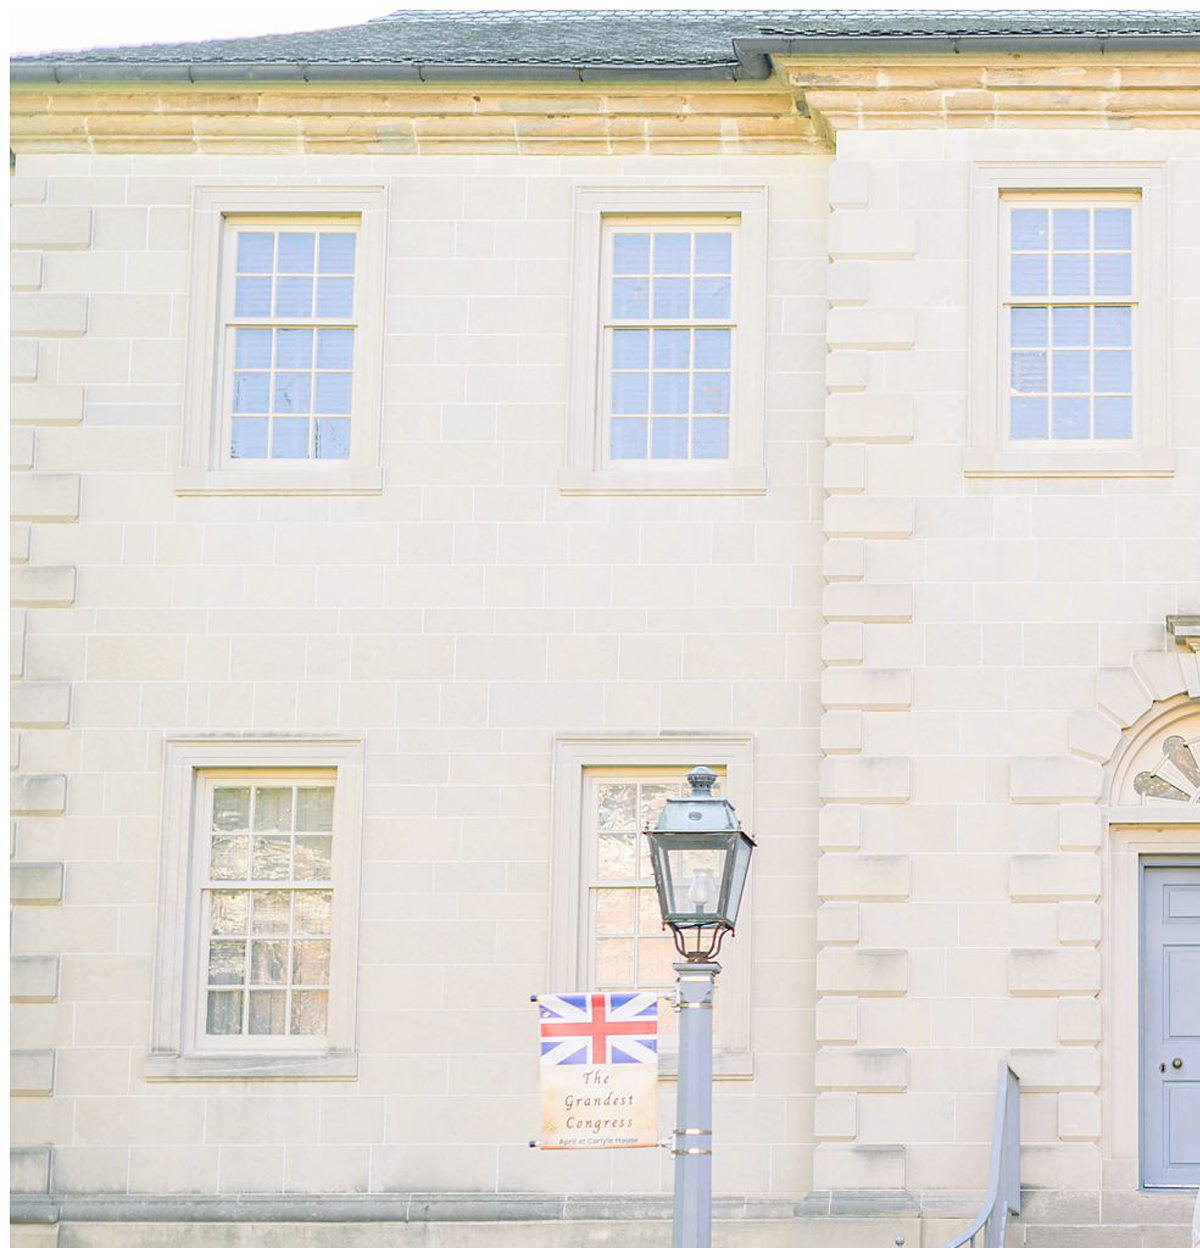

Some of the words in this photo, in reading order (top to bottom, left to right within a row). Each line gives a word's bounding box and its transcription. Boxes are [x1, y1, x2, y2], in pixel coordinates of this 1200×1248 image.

[583, 1069, 610, 1085] The
[565, 1092, 633, 1110] Grandest
[566, 1117, 633, 1134] Congress
